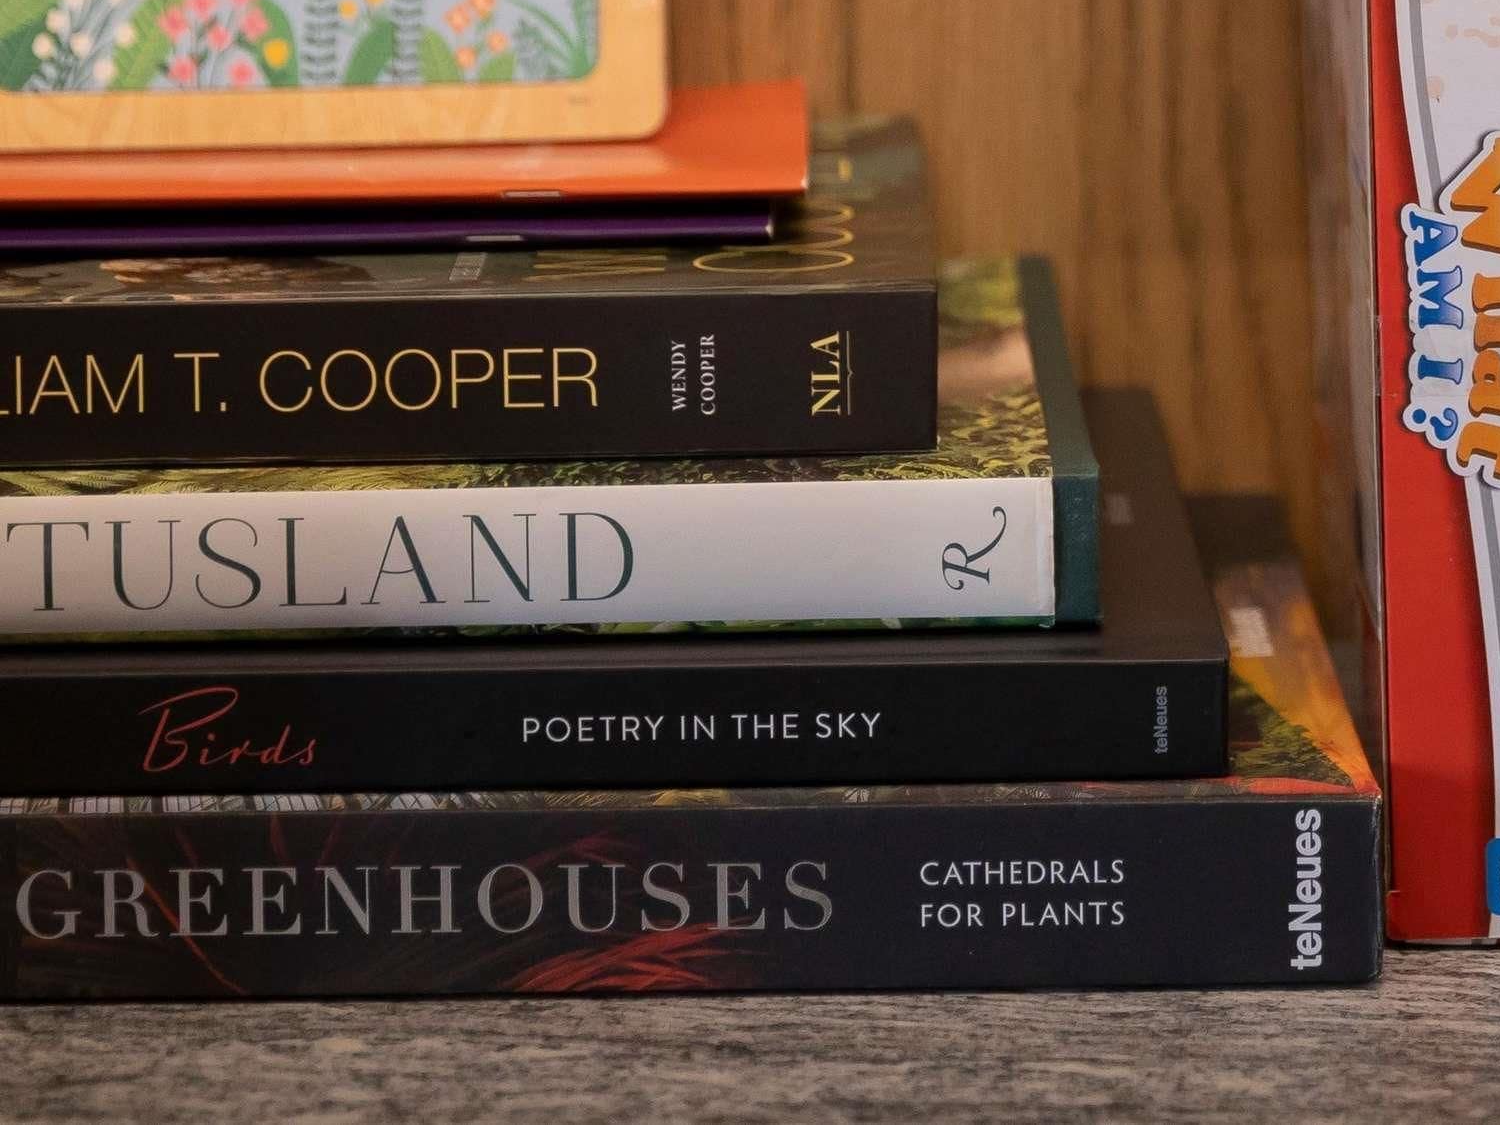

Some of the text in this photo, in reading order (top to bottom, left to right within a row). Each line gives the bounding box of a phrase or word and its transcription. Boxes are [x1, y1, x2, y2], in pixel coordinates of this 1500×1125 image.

[1408, 210, 1464, 330] AM
[0, 346, 599, 415] IAM T. COOPER
[671, 339, 688, 412] WENDY
[700, 334, 717, 415] COOPER
[810, 331, 842, 416] NLA
[6, 511, 635, 613] TUSLAND
[138, 686, 318, 772] Birds
[522, 711, 882, 743] POETRY IN THE SKY
[1152, 685, 1169, 756] teNeues
[15, 859, 835, 941] GREENHOUSES
[918, 859, 1126, 886] CATHEDRALS
[1288, 808, 1322, 971] teNeues
[919, 901, 1126, 929] FOR PLANTS
